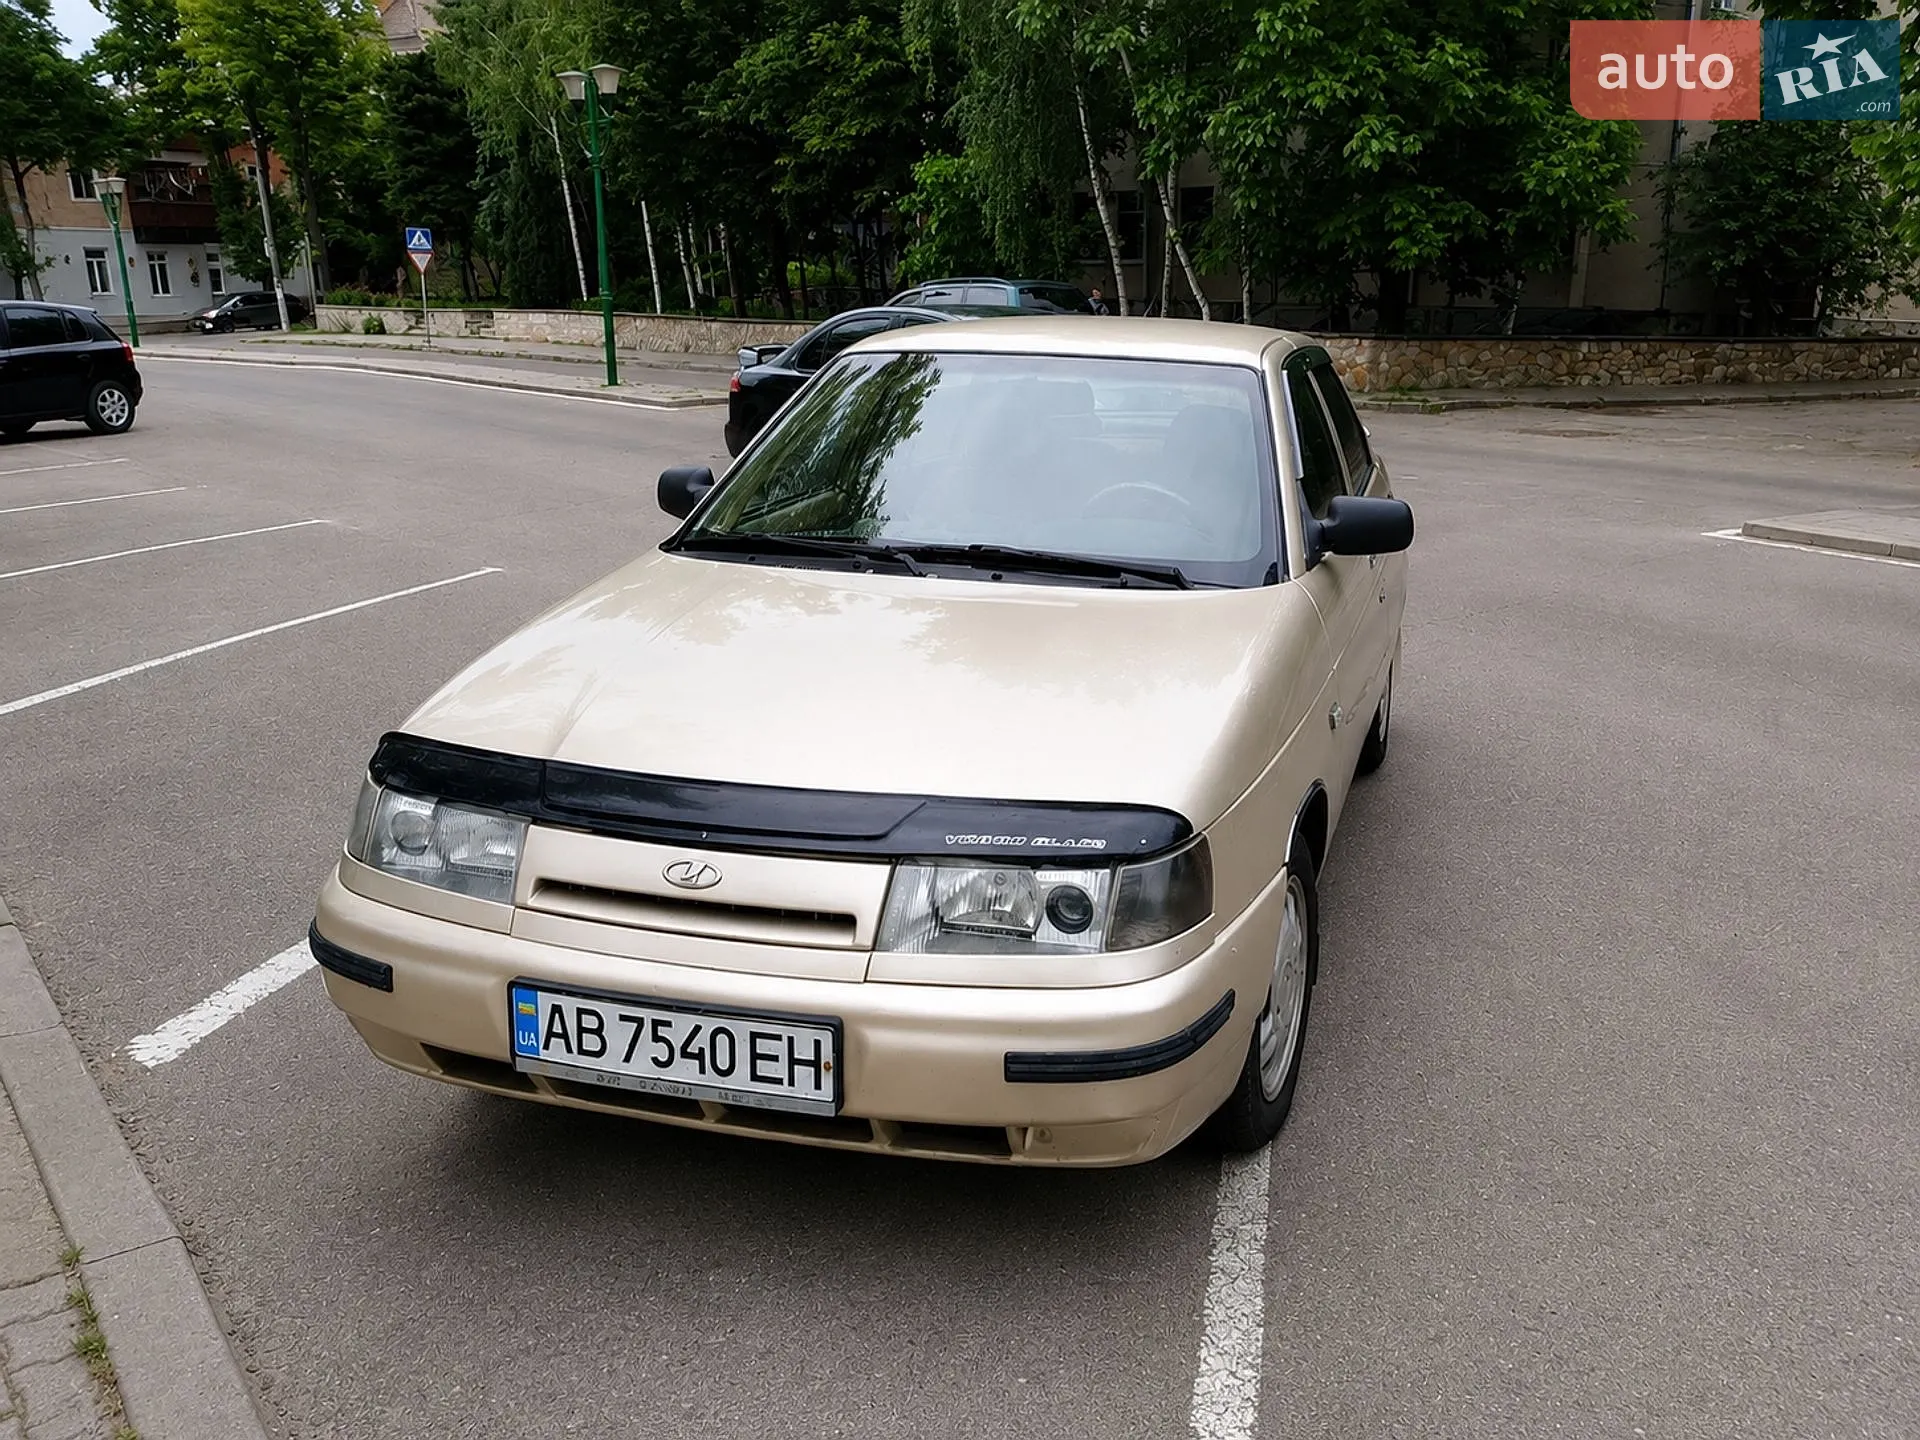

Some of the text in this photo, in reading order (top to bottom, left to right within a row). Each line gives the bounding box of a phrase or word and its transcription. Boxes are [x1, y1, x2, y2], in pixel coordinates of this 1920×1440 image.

[518, 1031, 538, 1048] UA
[542, 1003, 823, 1092] AB 7540 EH
